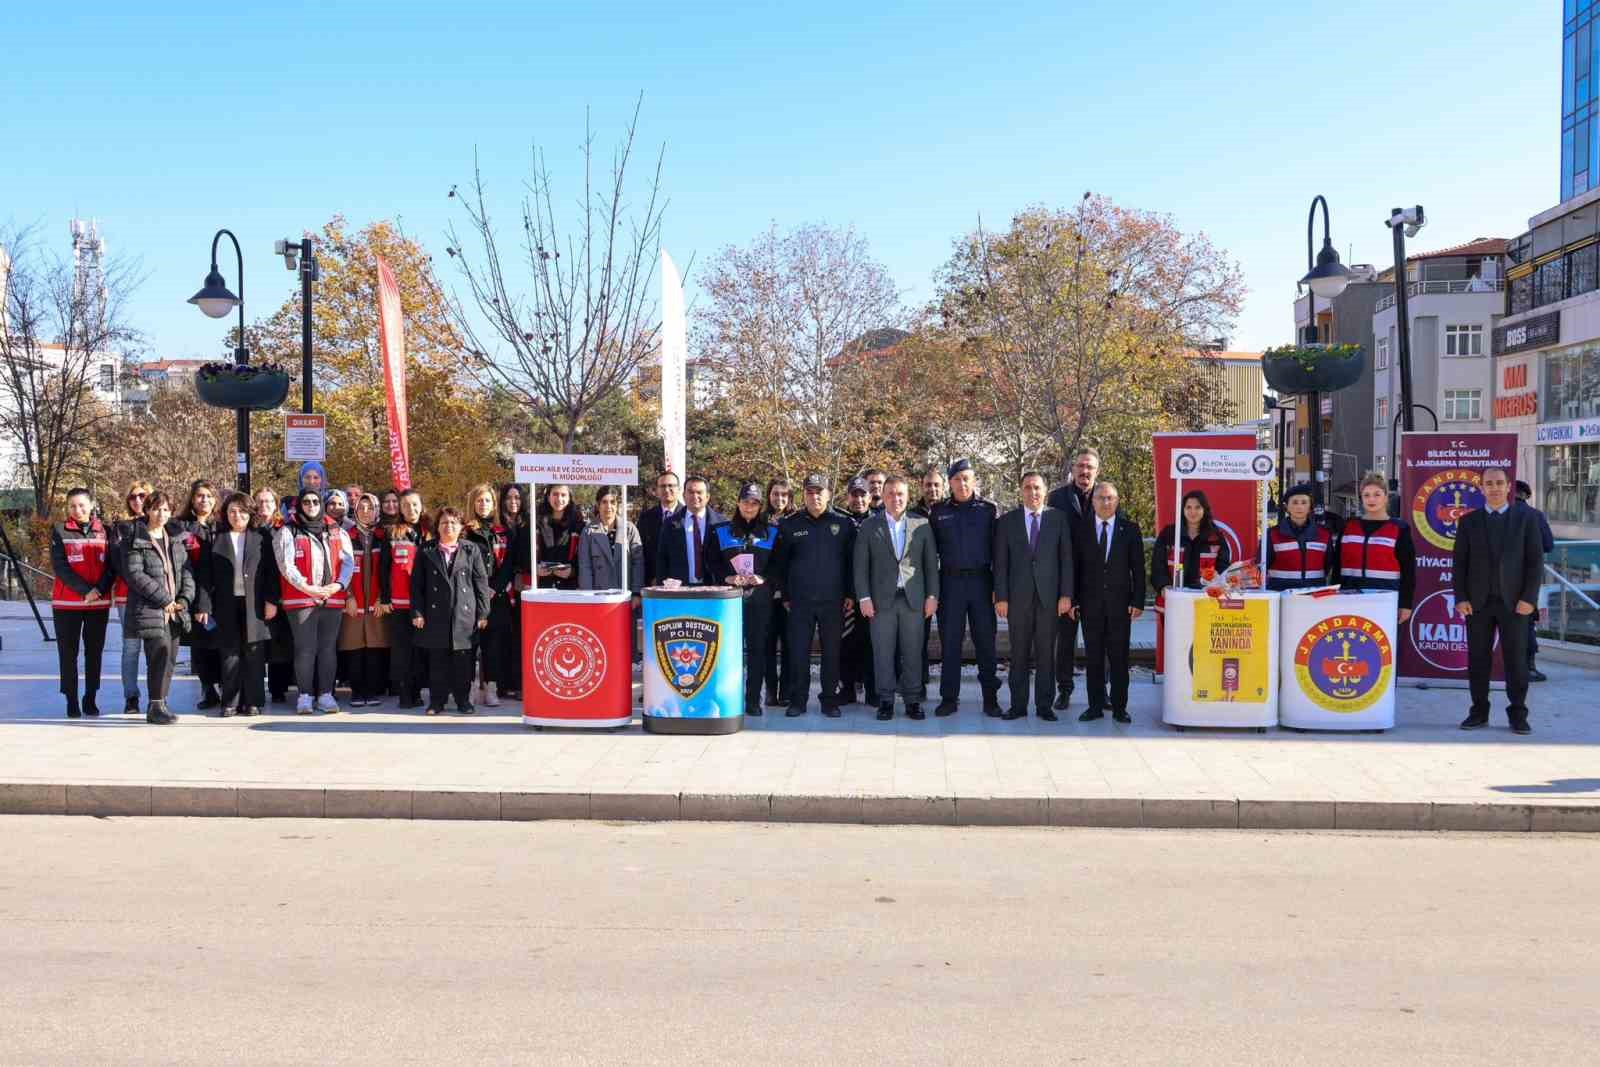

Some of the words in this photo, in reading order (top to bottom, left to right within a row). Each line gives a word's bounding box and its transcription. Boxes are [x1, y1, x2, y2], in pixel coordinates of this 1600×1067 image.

[1506, 326, 1527, 346] BOSS
[1418, 472, 1481, 503] JANDAR
[658, 622, 683, 632] TOPLUM
[670, 630, 703, 639] POLİS
[1300, 618, 1389, 655] JANDARMA
[1211, 638, 1251, 649] YANINDA
[1419, 642, 1448, 650] KADIN
